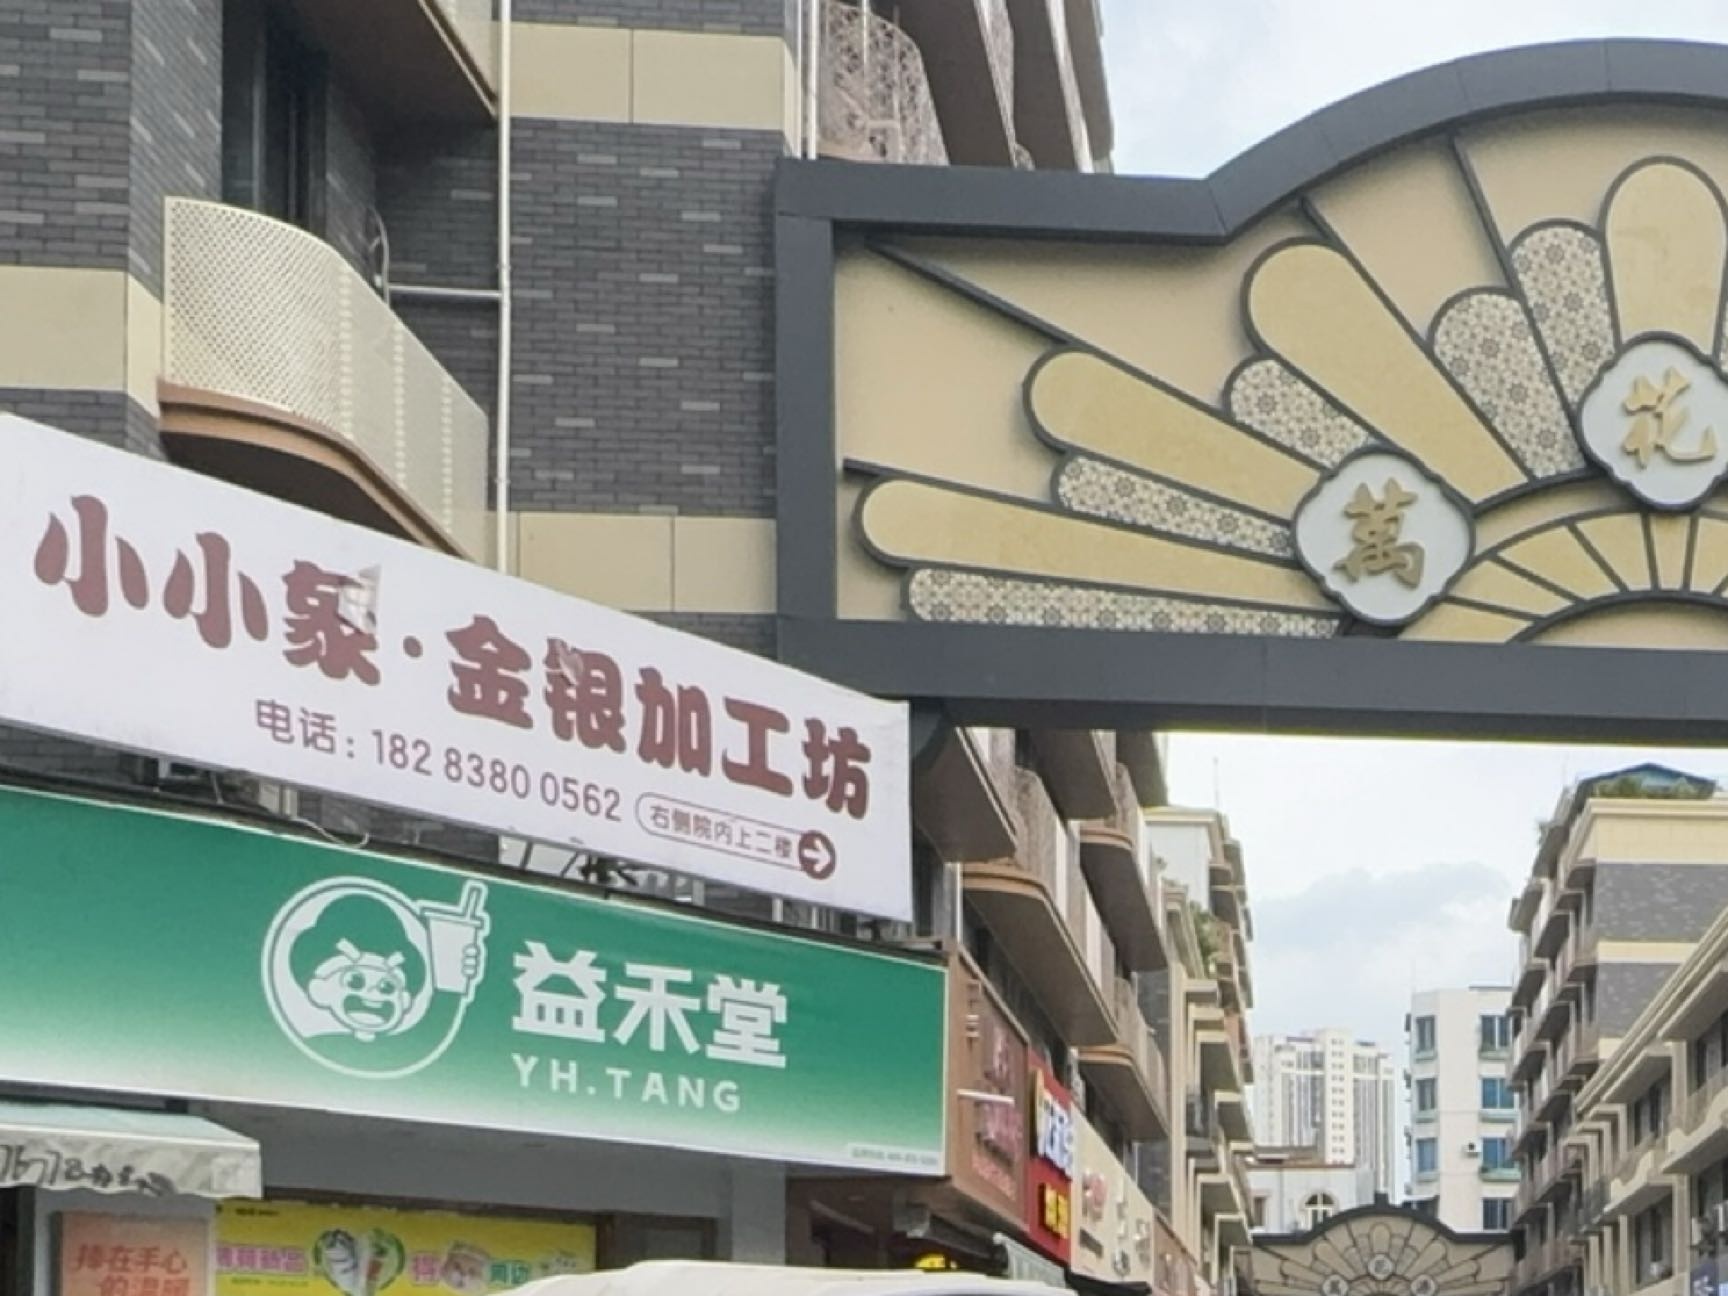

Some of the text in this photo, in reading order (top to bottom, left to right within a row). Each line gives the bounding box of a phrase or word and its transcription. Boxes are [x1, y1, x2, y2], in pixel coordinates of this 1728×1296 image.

[371, 727, 434, 777] 182
[443, 746, 533, 800] 8380
[538, 770, 624, 823] 0562
[649, 804, 793, 859] 右侧院内上二楼
[511, 940, 788, 1069] 益禾堂
[511, 1052, 741, 1113] YH.TANG
